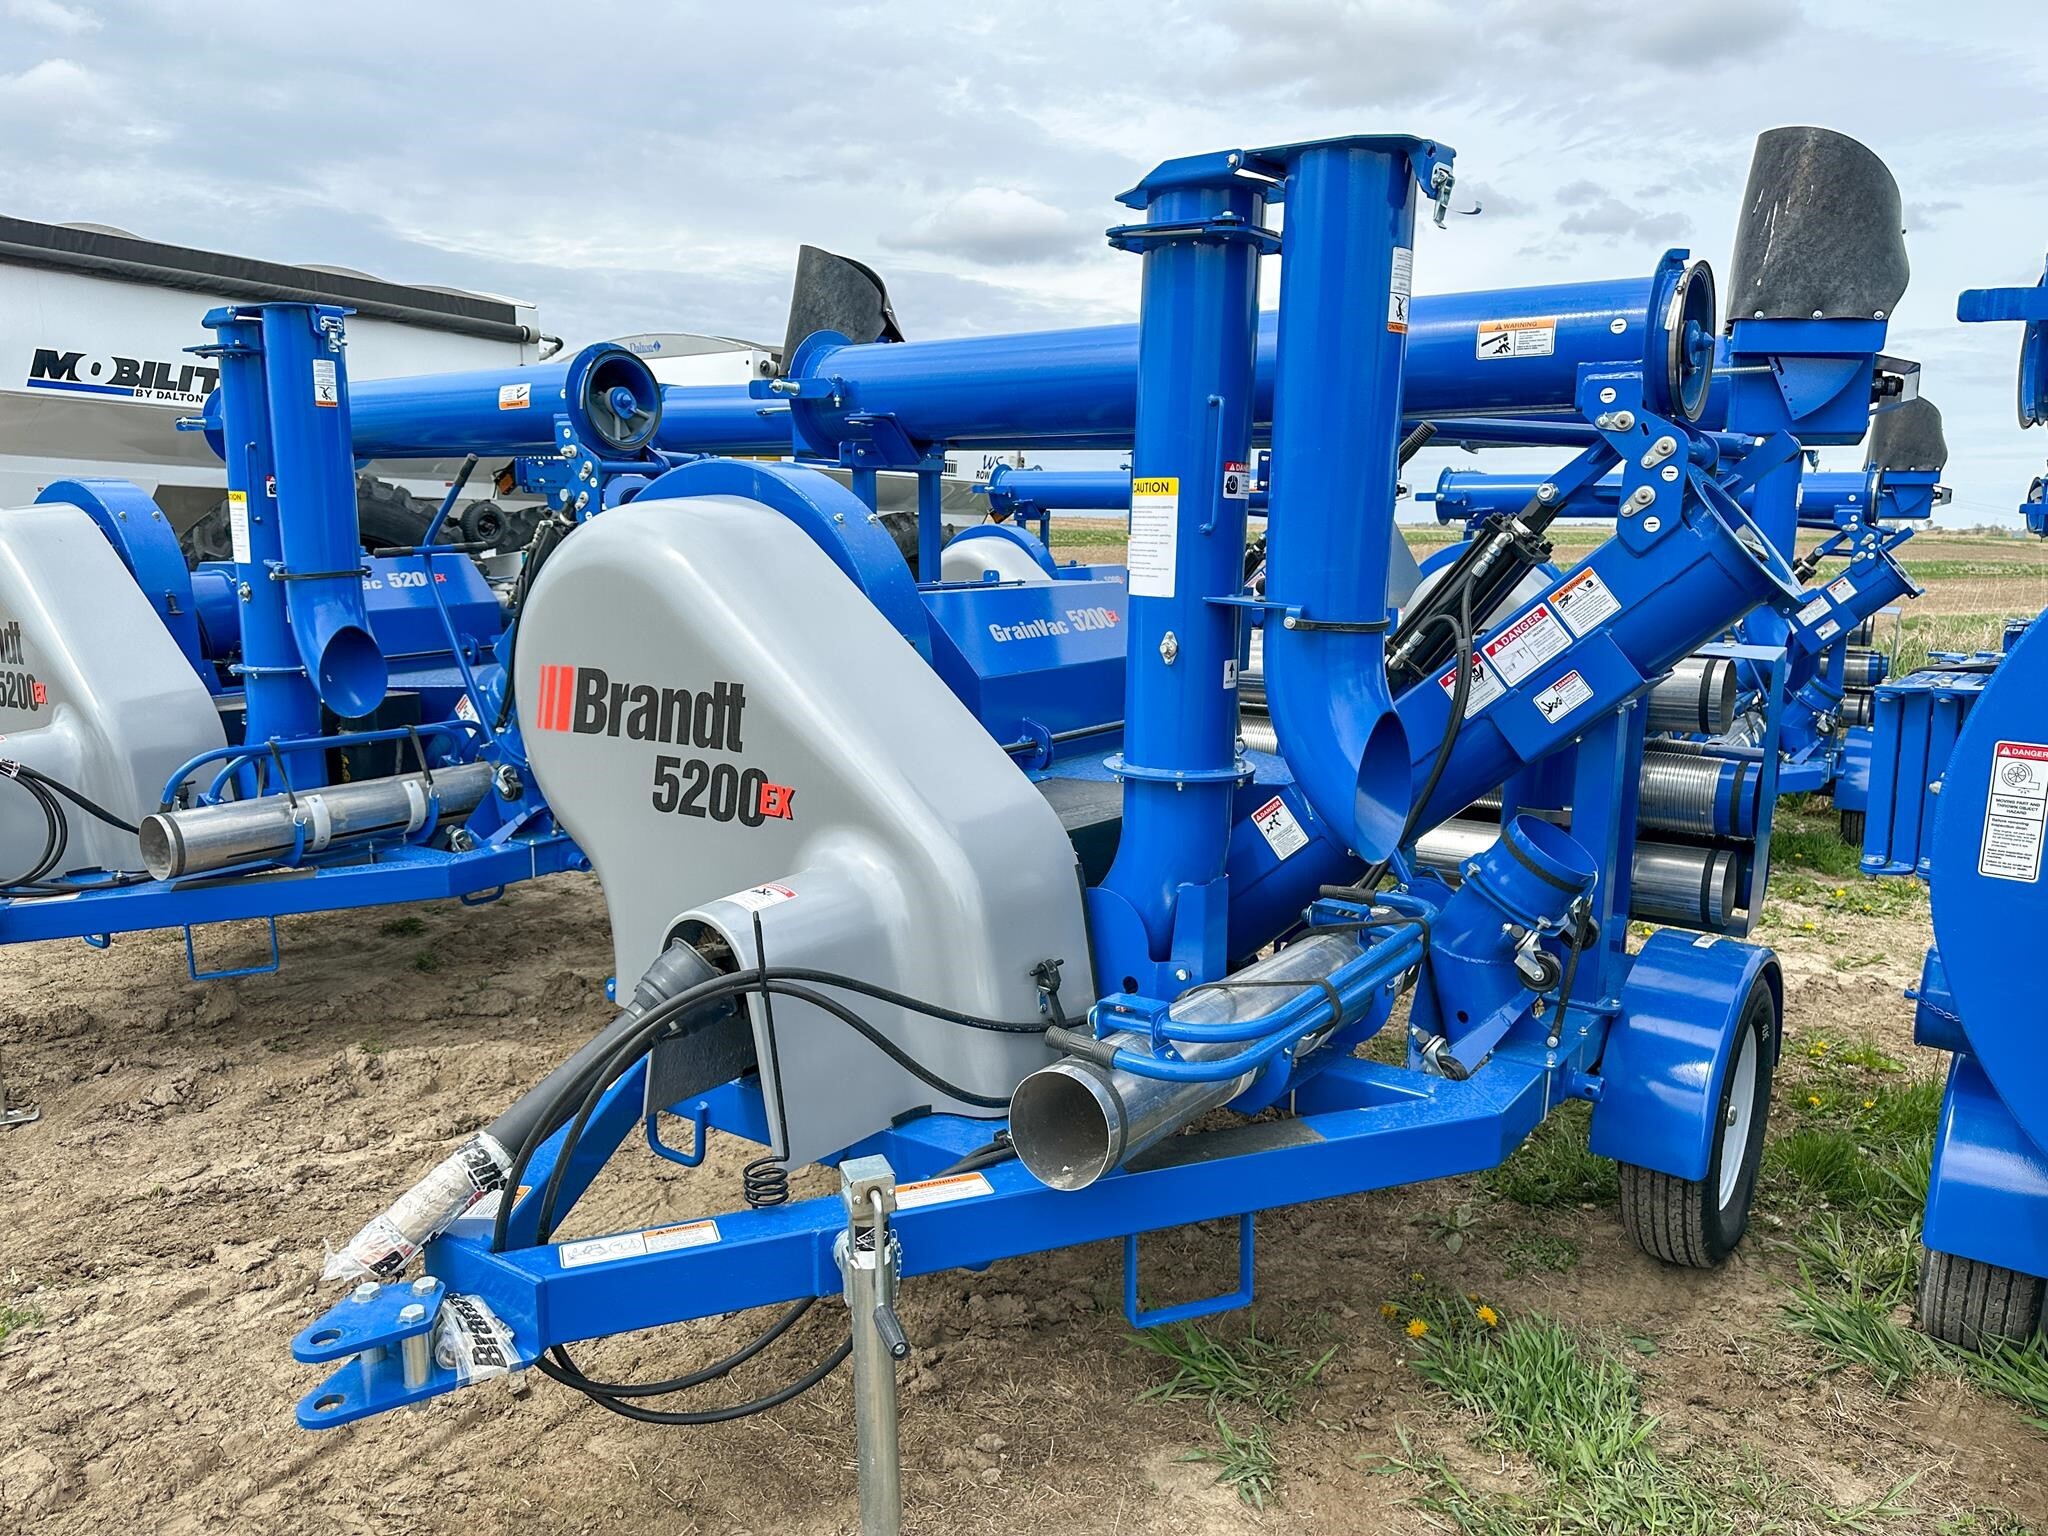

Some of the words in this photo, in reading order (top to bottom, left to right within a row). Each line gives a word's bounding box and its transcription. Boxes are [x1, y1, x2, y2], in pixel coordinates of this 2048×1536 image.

[1503, 321, 1537, 330] WARNING
[30, 348, 219, 394] MOBILIT
[135, 388, 152, 398] BY
[156, 389, 204, 403] DALTON
[989, 618, 1069, 643] GrainVac
[1500, 611, 1543, 645] DANGER
[572, 667, 746, 753] Brandt
[2011, 748, 2048, 758] DANGER
[1260, 801, 1280, 818] DANGER
[918, 1177, 961, 1188] WARNING
